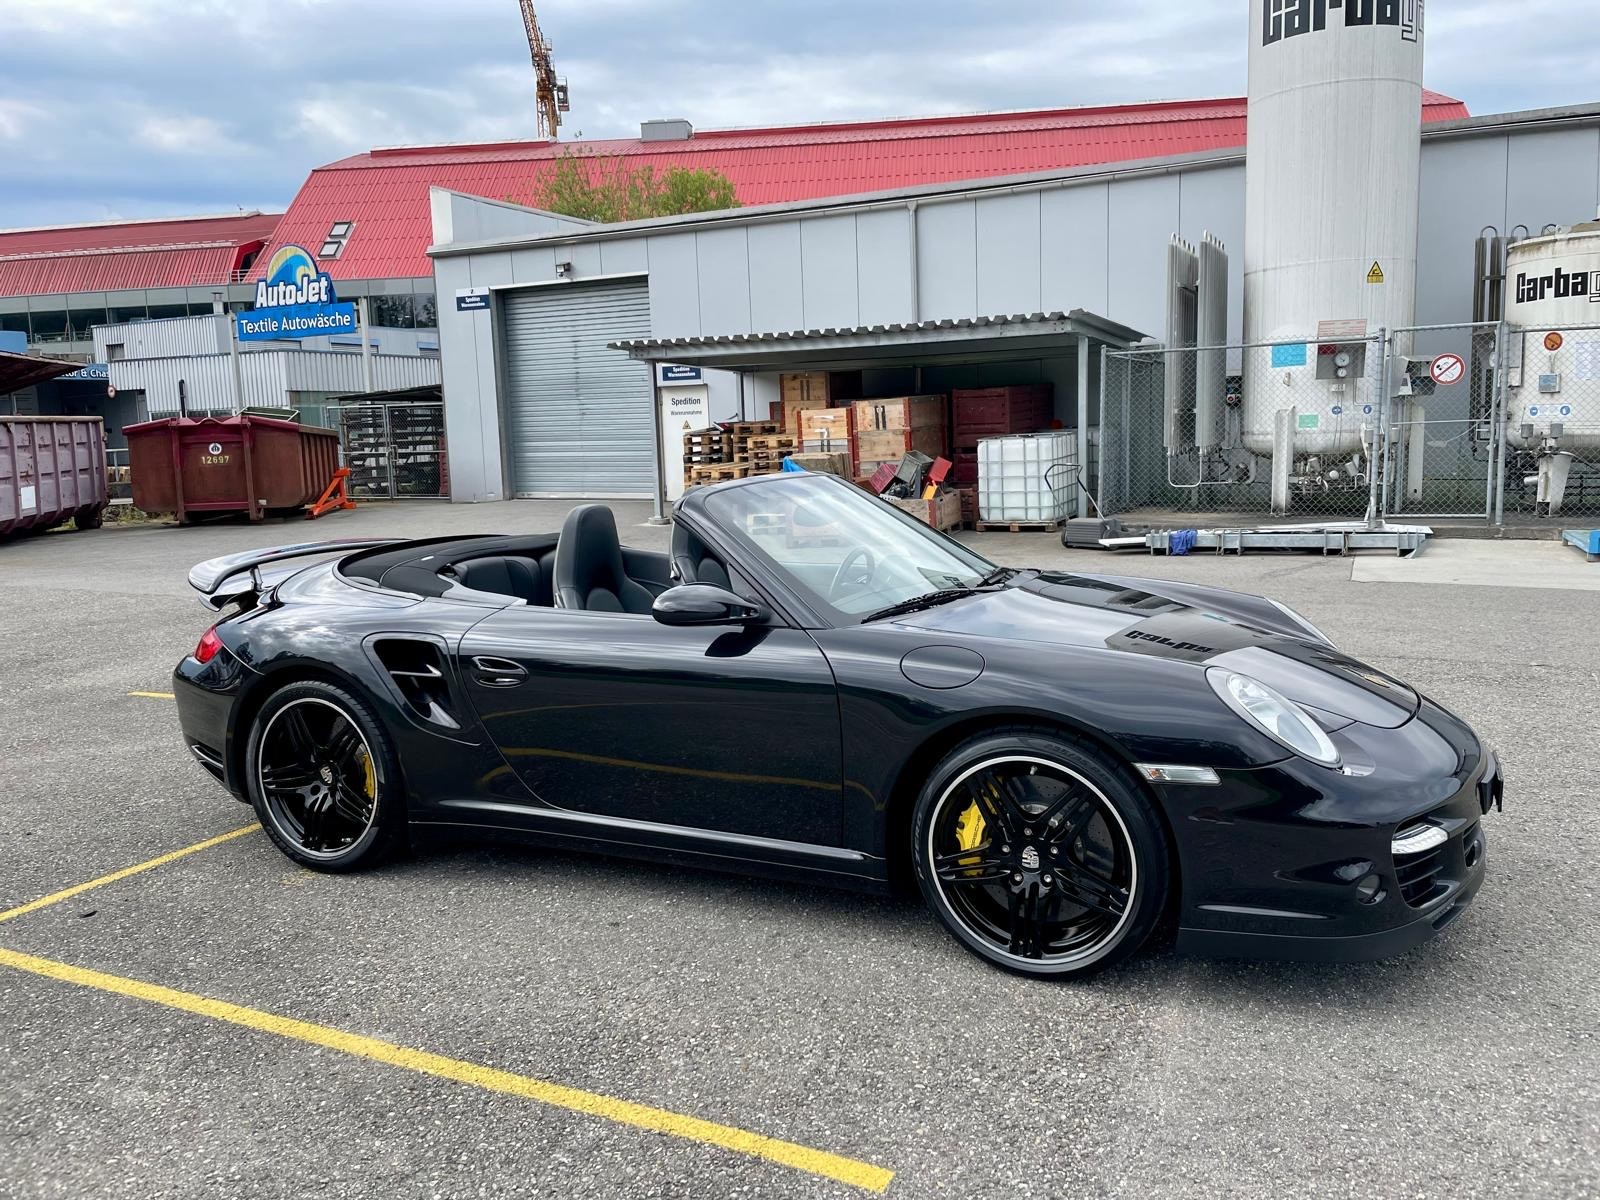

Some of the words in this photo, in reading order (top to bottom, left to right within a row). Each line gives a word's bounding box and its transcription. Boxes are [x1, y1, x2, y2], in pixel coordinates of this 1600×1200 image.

[256, 276, 328, 308] AutoJet
[241, 319, 278, 334] Textile
[281, 312, 350, 331] Autowäsche
[81, 369, 87, 377] &
[671, 397, 701, 406] Spedition
[201, 455, 229, 465] 12697
